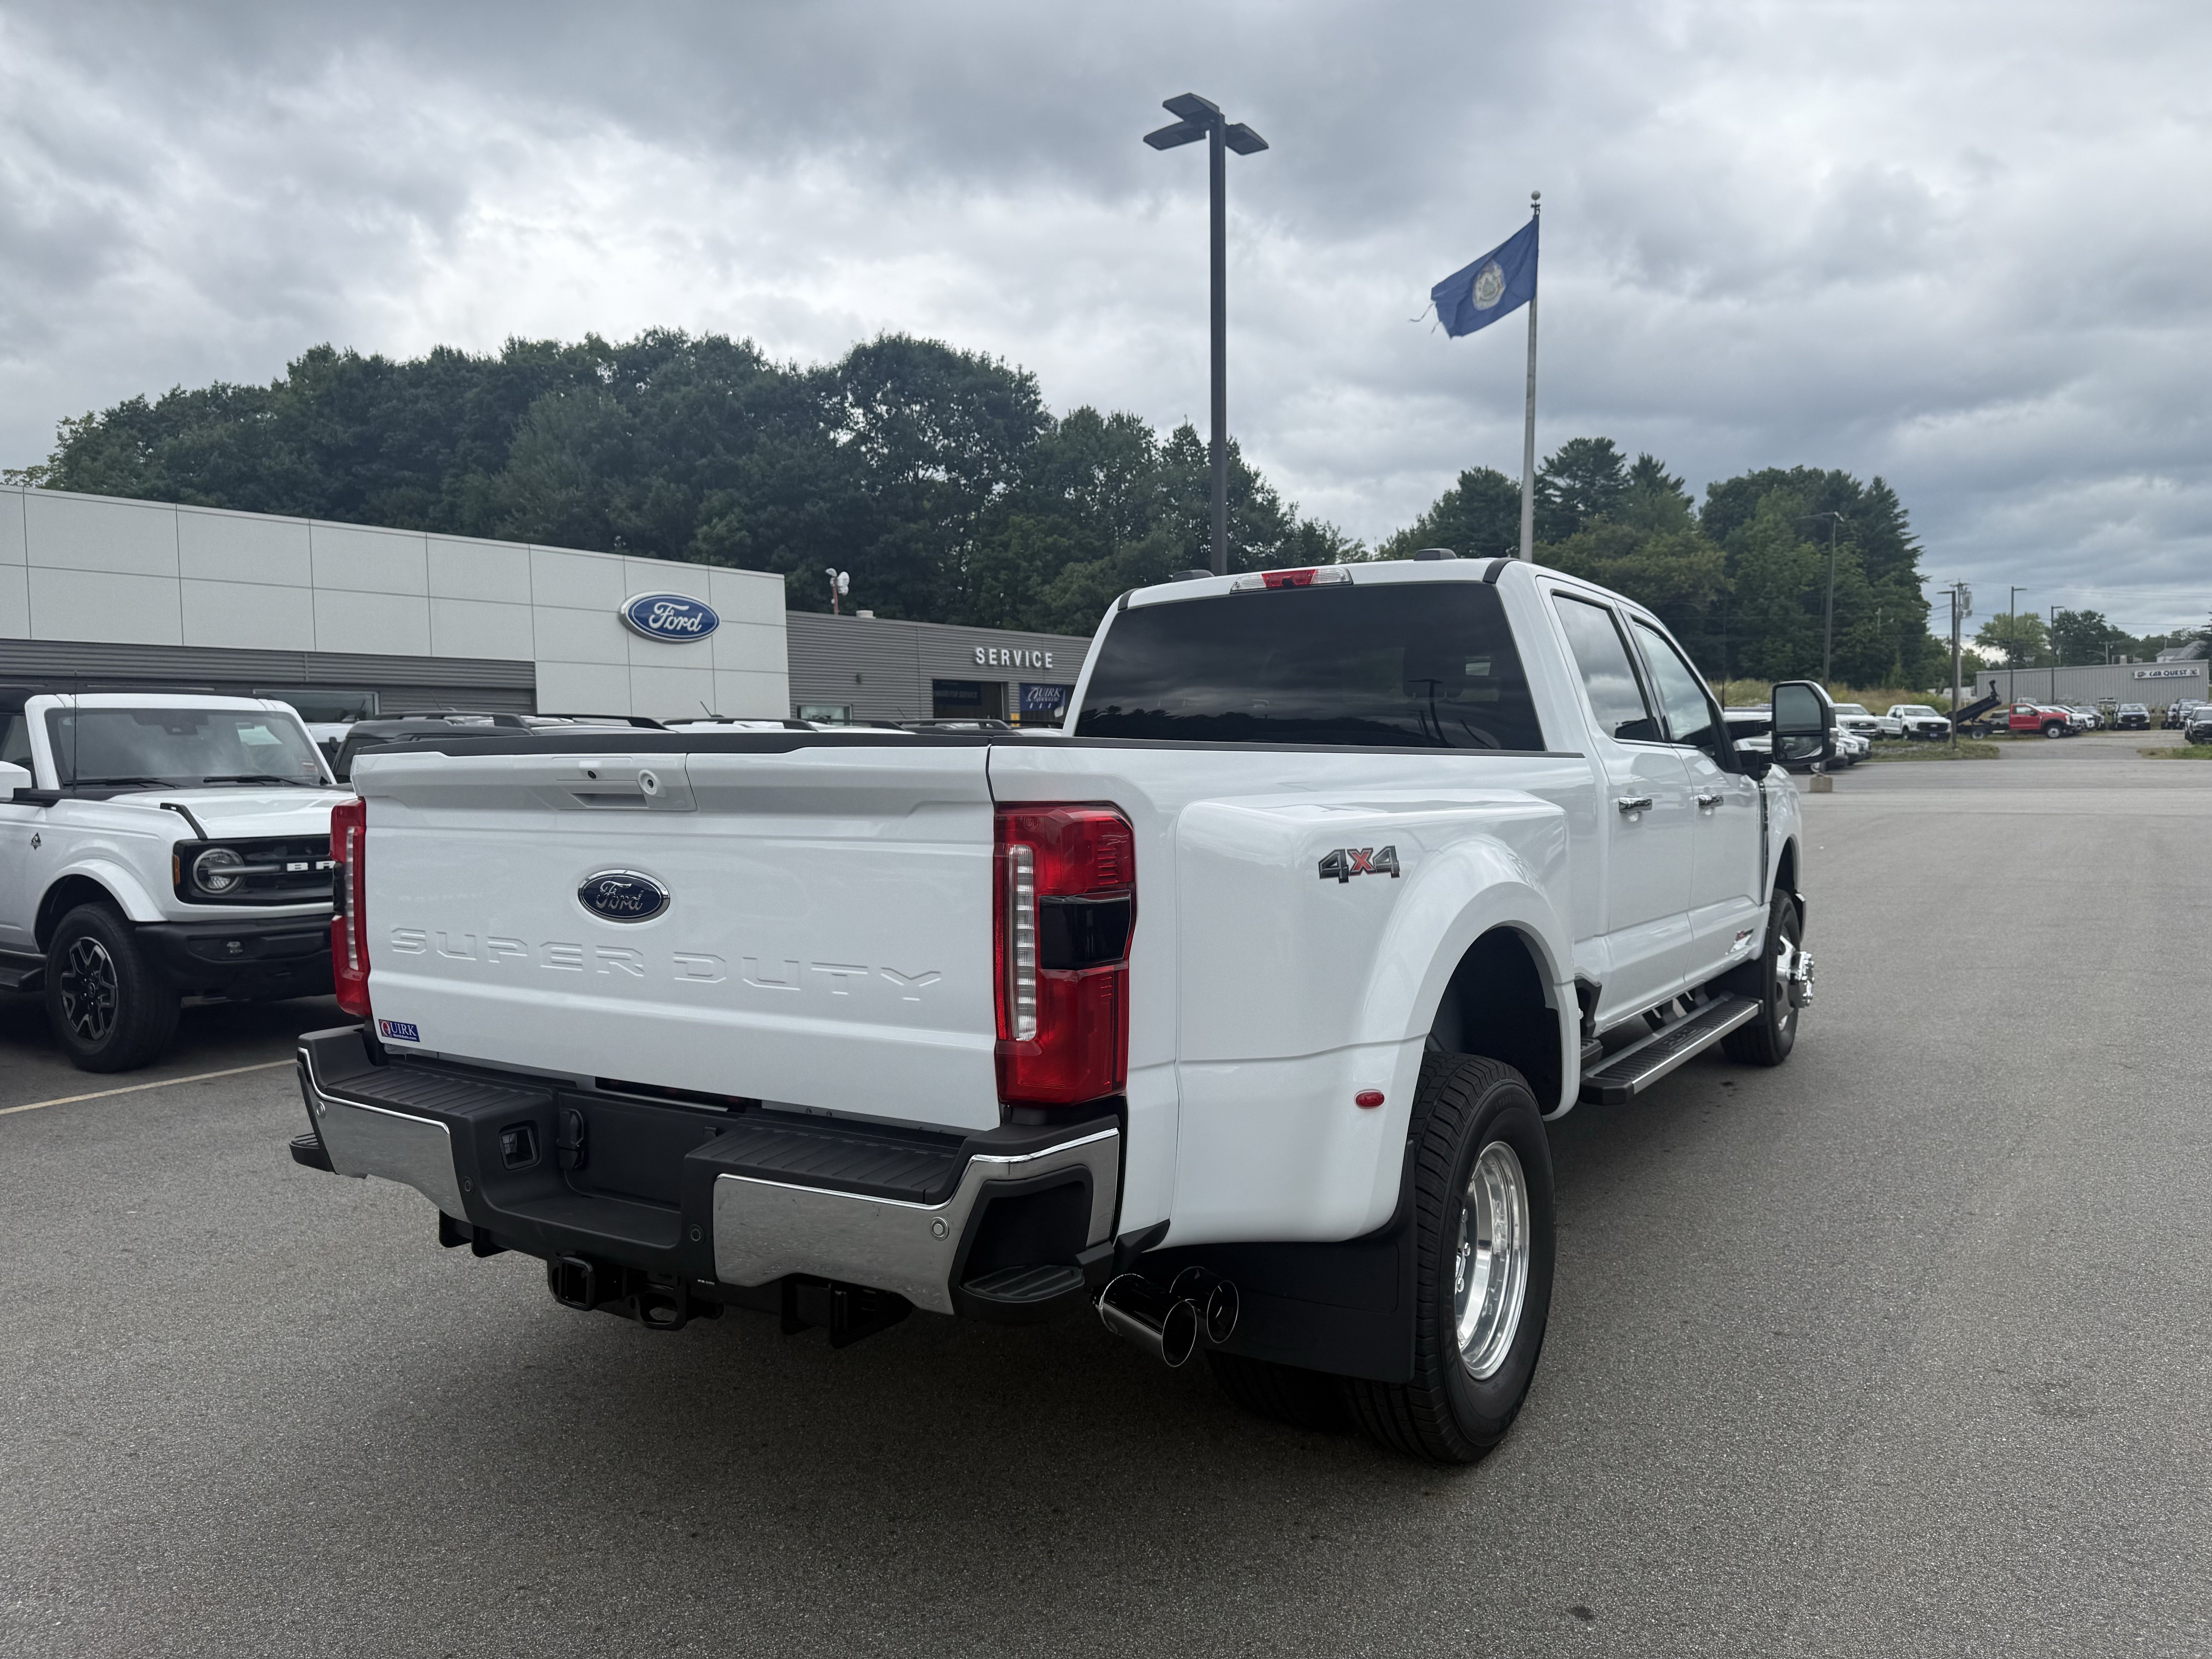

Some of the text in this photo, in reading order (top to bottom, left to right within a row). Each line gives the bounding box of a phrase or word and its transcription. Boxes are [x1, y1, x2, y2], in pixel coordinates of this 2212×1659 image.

[649, 601, 703, 632] Ford
[975, 647, 1053, 669] SERVICE
[1025, 686, 1061, 702] QUIRK
[596, 881, 644, 910] Ford
[391, 927, 941, 1001] SUPER DUTY
[381, 1021, 417, 1036] QUIRK
